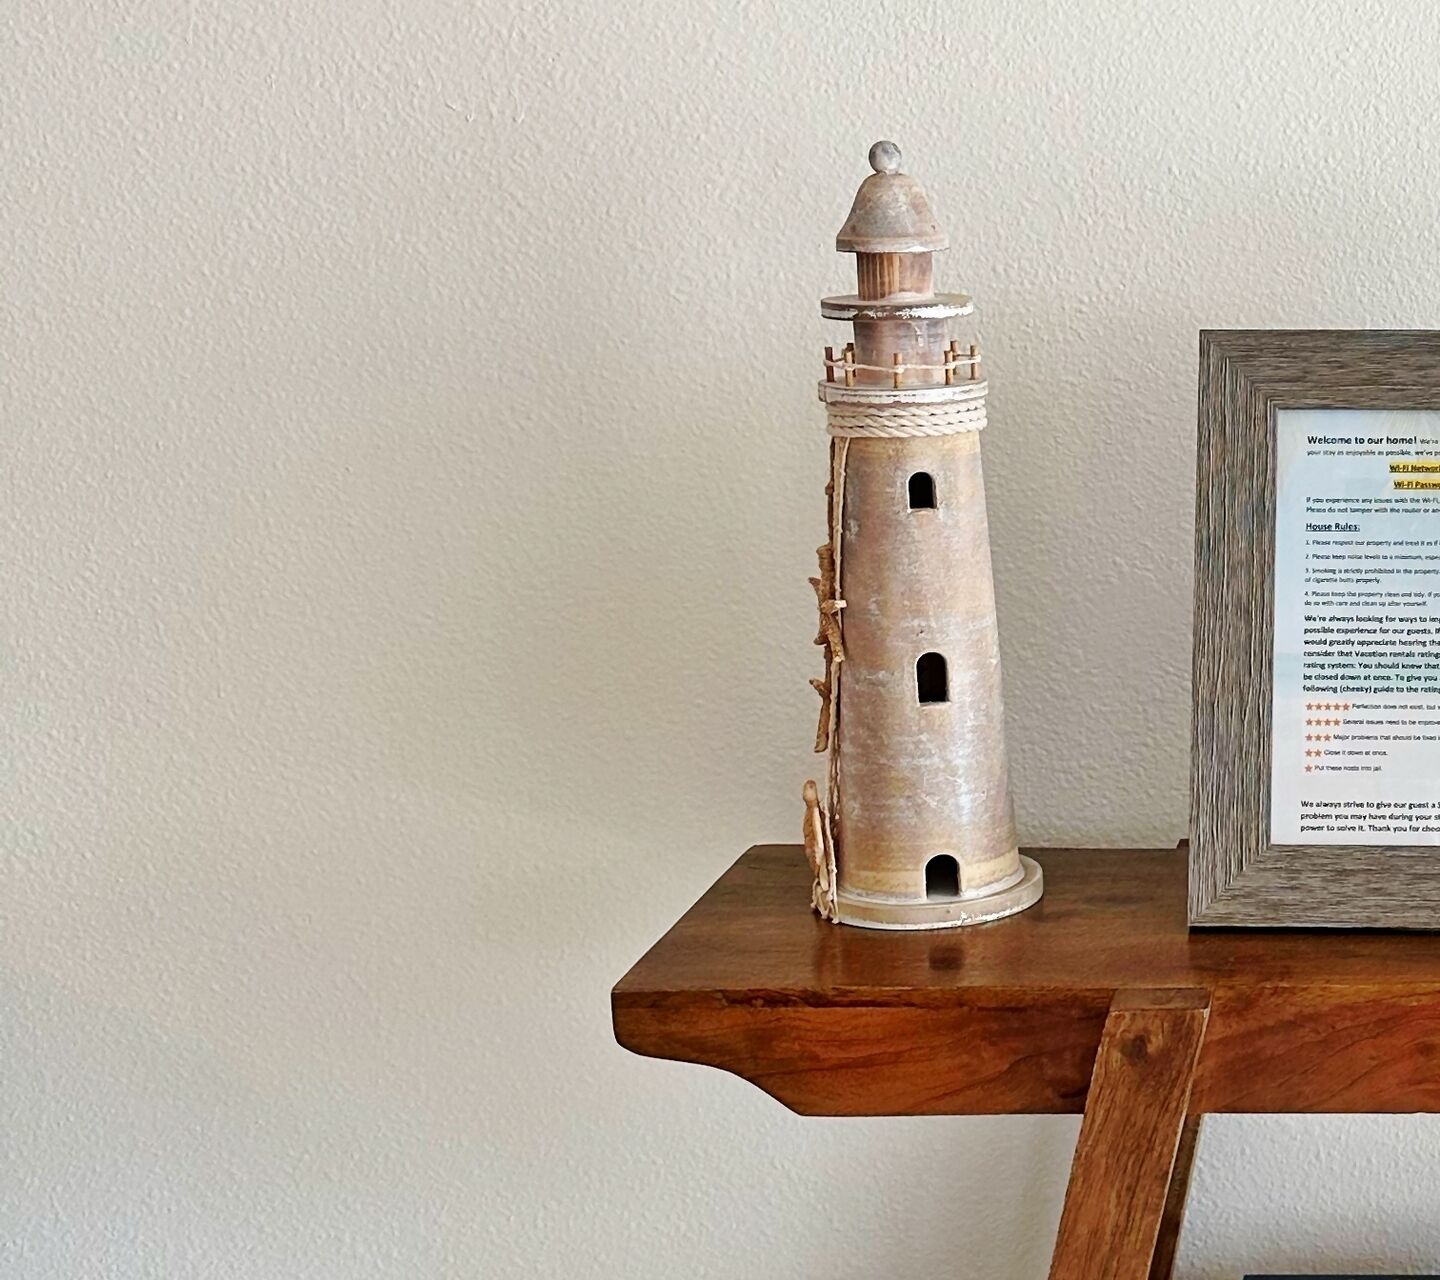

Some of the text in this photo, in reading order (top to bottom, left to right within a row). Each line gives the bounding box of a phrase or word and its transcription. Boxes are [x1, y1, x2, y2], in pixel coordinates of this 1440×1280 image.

[1307, 435, 1352, 444] Welcome
[1354, 435, 1365, 444] to
[1385, 435, 1417, 444] home!
[1305, 522, 1360, 531] House Rules:
[1328, 615, 1354, 624] always
[1355, 615, 1384, 624] looking
[1384, 615, 1396, 623] for
[1418, 615, 1427, 623] to
[1304, 626, 1334, 636] possible
[1335, 627, 1377, 636] experience
[1434, 627, 1440, 635] If
[1354, 650, 1387, 658] Vacation
[1388, 650, 1415, 658] rentals
[1315, 801, 1341, 810] always
[1375, 801, 1391, 810] give
[1407, 801, 1429, 810] guest
[1300, 812, 1332, 822] problem
[1334, 814, 1348, 822] you
[1350, 814, 1366, 822] may
[1388, 813, 1413, 822] during
[1325, 824, 1335, 832] to
[1336, 824, 1356, 832] solve
[1392, 826, 1407, 834] you
